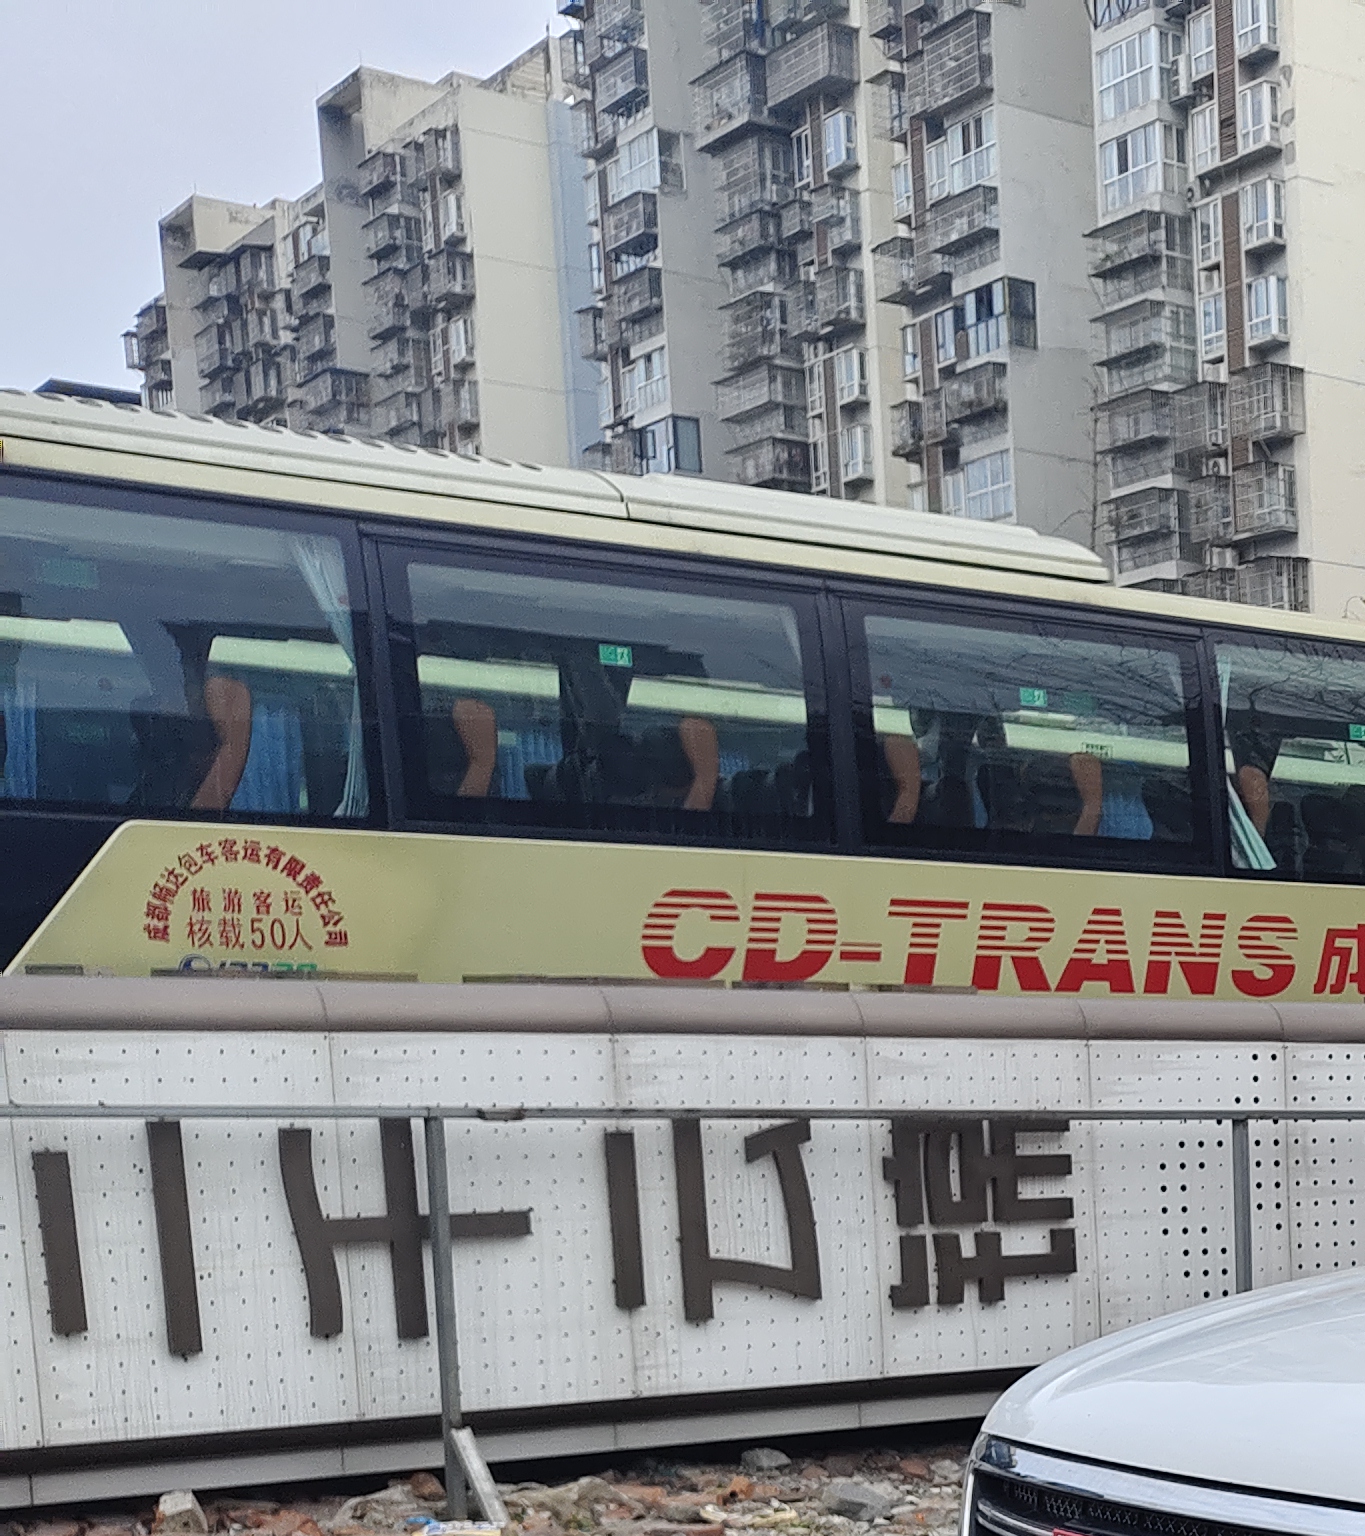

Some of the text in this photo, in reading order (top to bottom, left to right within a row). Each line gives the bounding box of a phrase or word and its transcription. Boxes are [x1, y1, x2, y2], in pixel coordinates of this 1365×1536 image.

[190, 887, 303, 917] 旅游客运
[187, 917, 313, 951] 核载50人
[641, 888, 1299, 998] CD-TRANS
